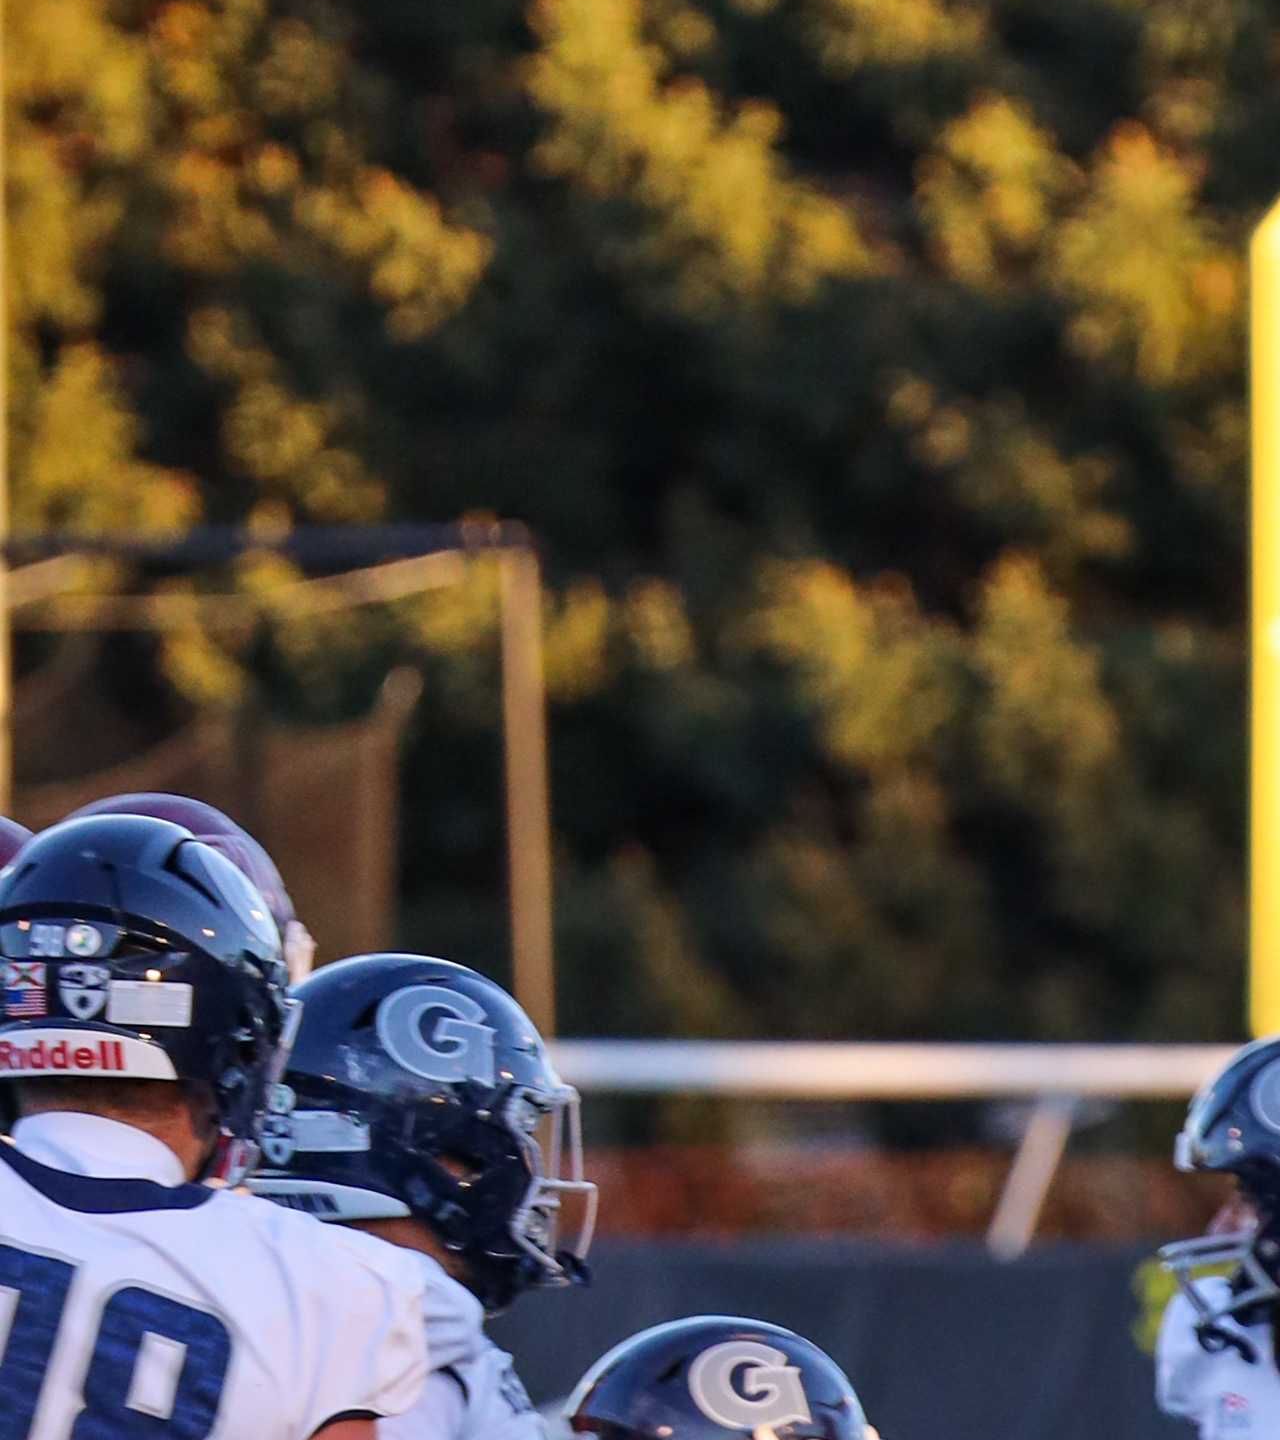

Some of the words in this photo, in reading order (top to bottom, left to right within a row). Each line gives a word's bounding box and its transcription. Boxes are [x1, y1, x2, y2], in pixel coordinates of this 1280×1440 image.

[0, 1040, 125, 1071] Riddell
[376, 985, 498, 1089] G
[687, 1340, 812, 1430] G
